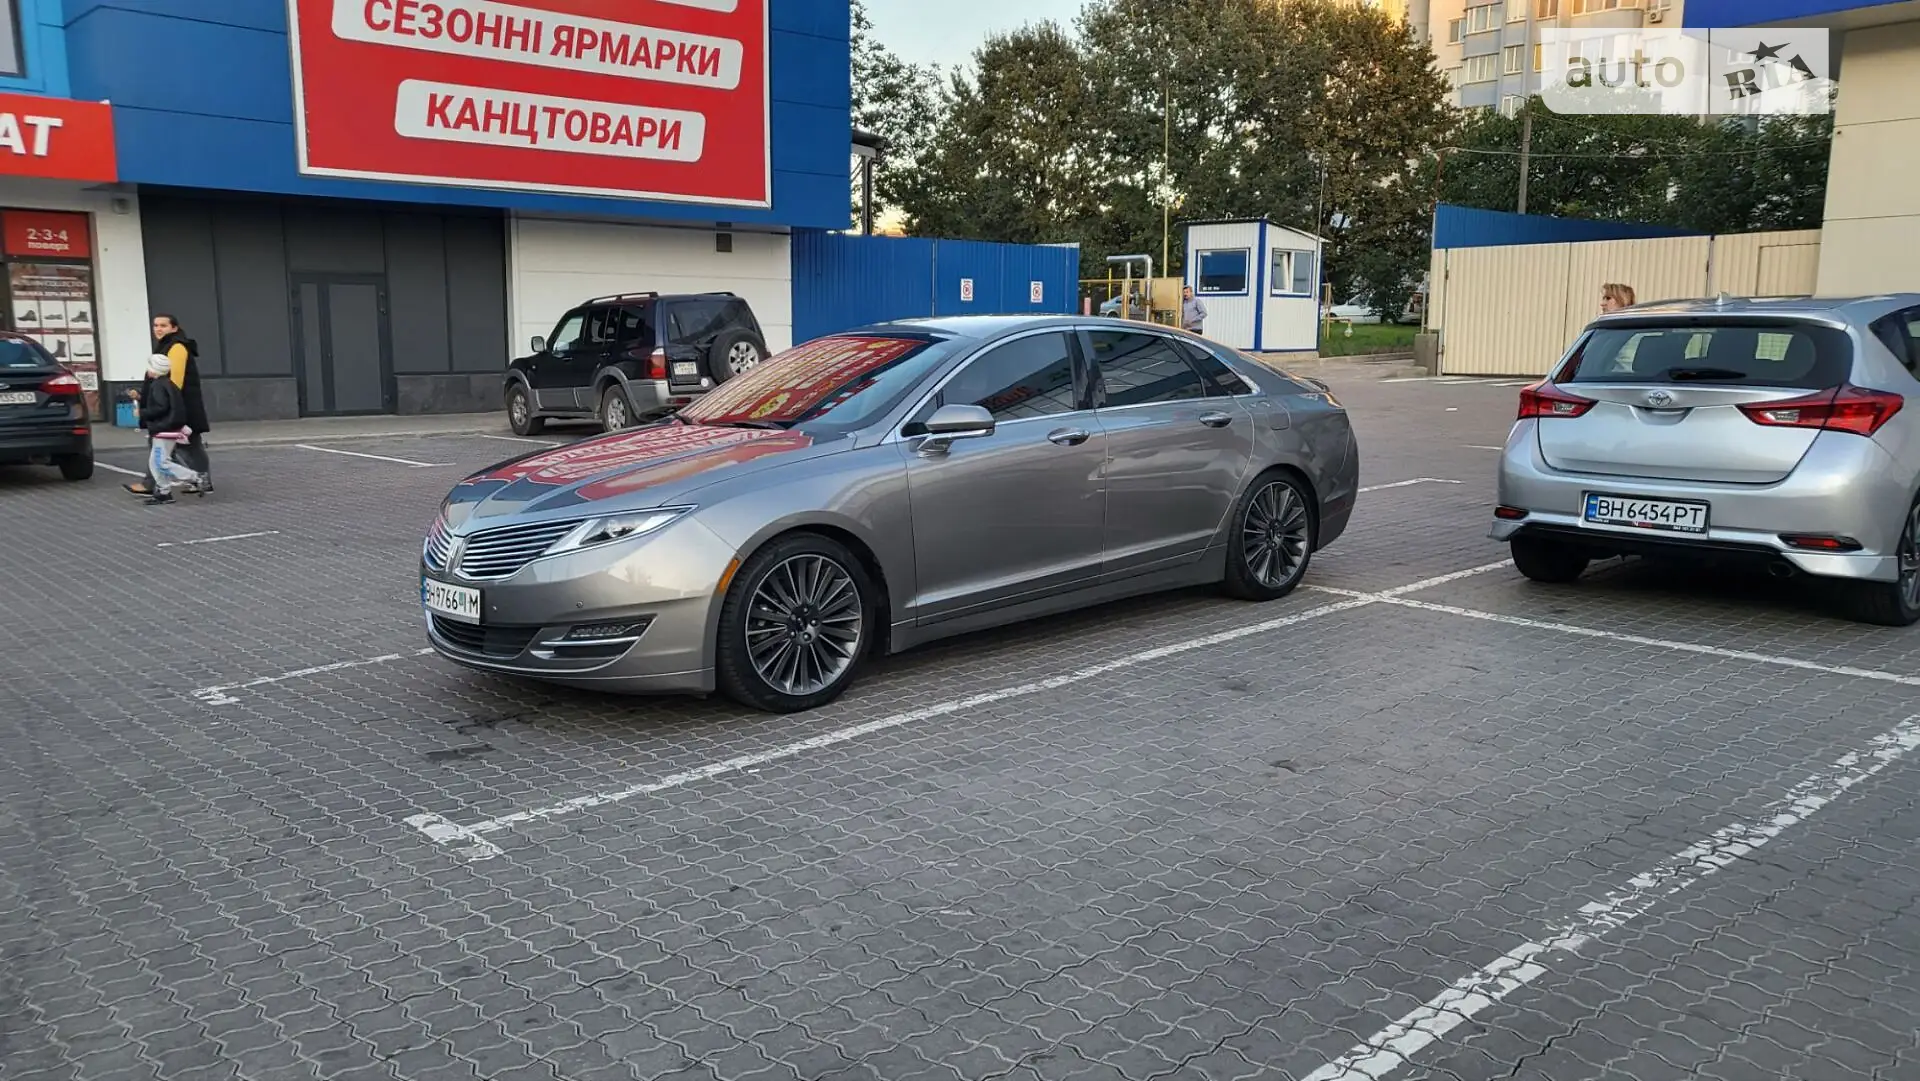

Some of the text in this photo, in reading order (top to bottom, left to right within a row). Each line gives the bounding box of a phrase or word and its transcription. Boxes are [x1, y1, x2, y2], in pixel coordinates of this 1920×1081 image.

[364, 0, 721, 77] СЕЗОННІ ЯРМАРКИ
[425, 92, 682, 150] КАНЦТОВАРИ
